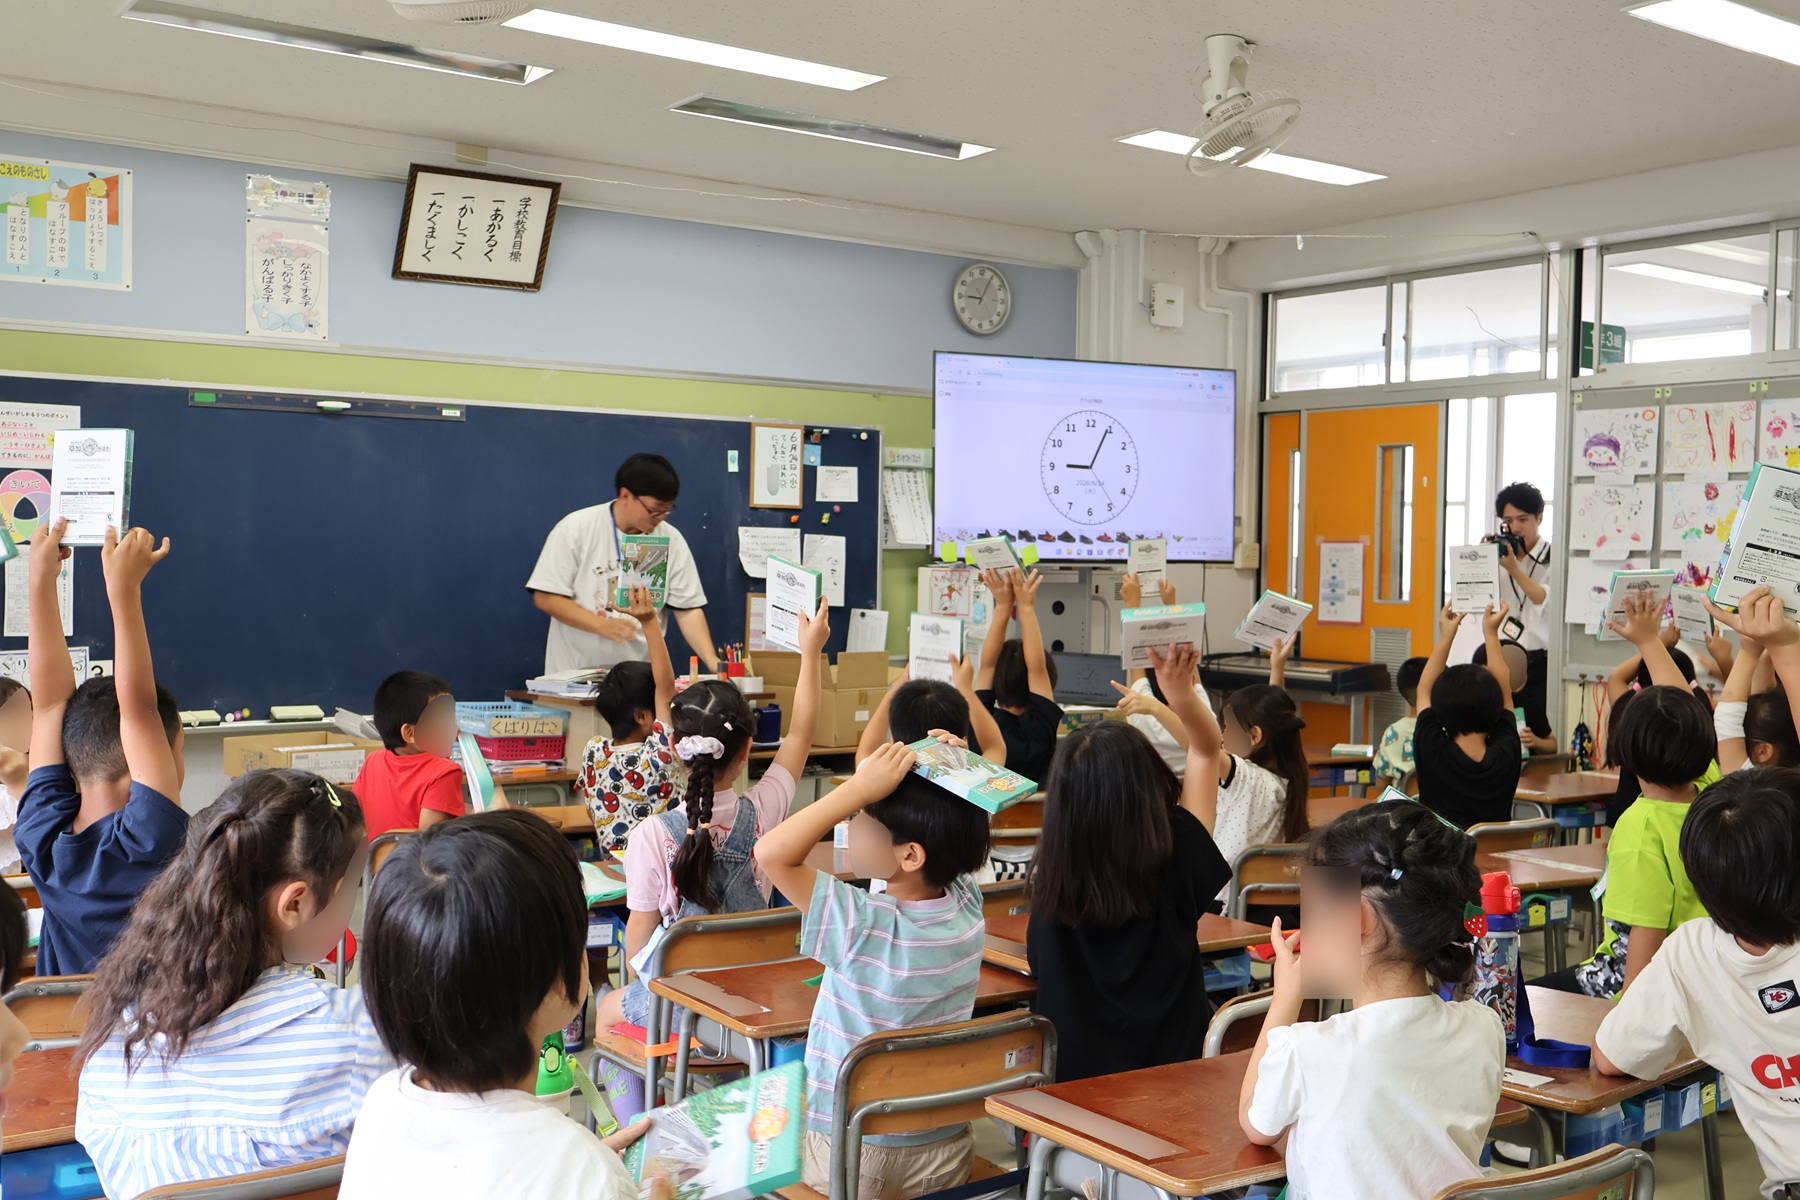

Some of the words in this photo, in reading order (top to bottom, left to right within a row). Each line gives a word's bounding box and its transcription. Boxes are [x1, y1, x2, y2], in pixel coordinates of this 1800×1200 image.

[58, 203, 67, 262] グループの中で
[508, 196, 532, 262] 学校教育目標
[9, 216, 17, 260] はなすこえ
[19, 208, 27, 261] となりの人と
[48, 220, 56, 263] はなすこえ
[261, 258, 275, 303] がんばる子
[281, 259, 294, 304] しっかりきく子
[299, 262, 312, 307] なかよくする子
[1066, 424, 1076, 432] 11
[1086, 419, 1096, 428] 12
[1107, 426, 1113, 434] 1
[1052, 439, 1063, 448] 10
[1121, 442, 1127, 451] 2
[1049, 462, 1055, 471] 9
[1125, 465, 1131, 473] 3
[9, 479, 41, 490] きいて
[1053, 485, 1059, 494] 8
[1120, 488, 1126, 496] 4
[1067, 502, 1073, 510] 7
[1107, 503, 1113, 512] 5
[1087, 508, 1093, 516] 6
[1769, 990, 1788, 1003] KC
[1008, 1052, 1014, 1063] 7
